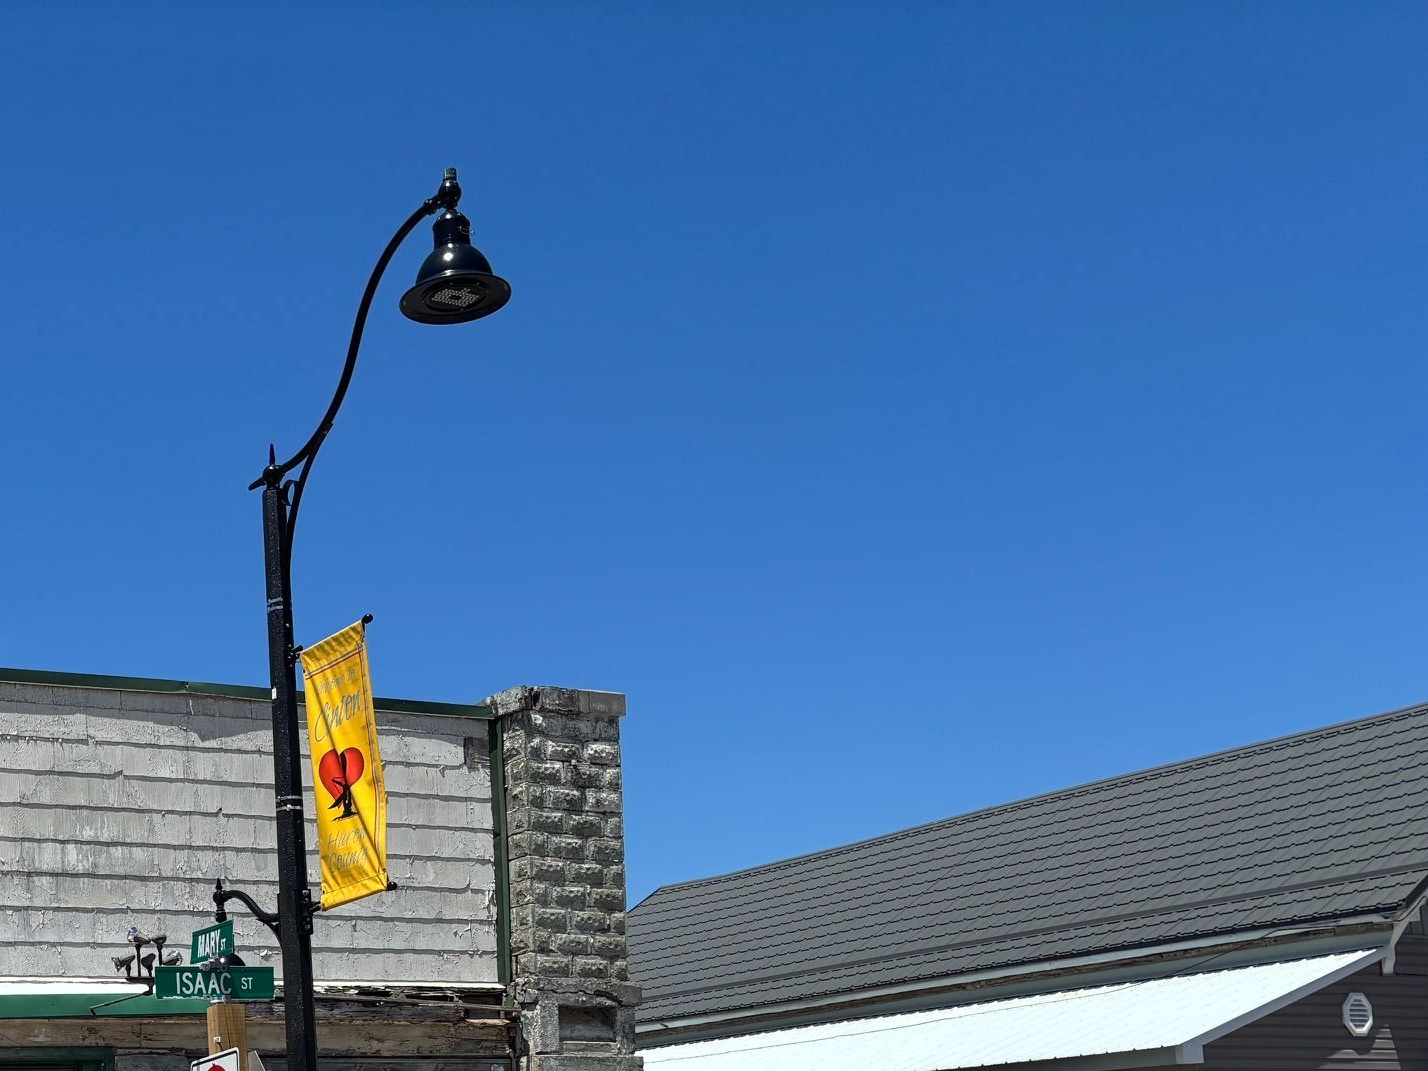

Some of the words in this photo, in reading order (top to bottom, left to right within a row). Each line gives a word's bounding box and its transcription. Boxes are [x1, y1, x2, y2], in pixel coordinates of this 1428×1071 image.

[198, 929, 221, 957] MARY
[220, 938, 226, 951] ST
[176, 972, 232, 994] ISAAC
[241, 977, 253, 989] ST
